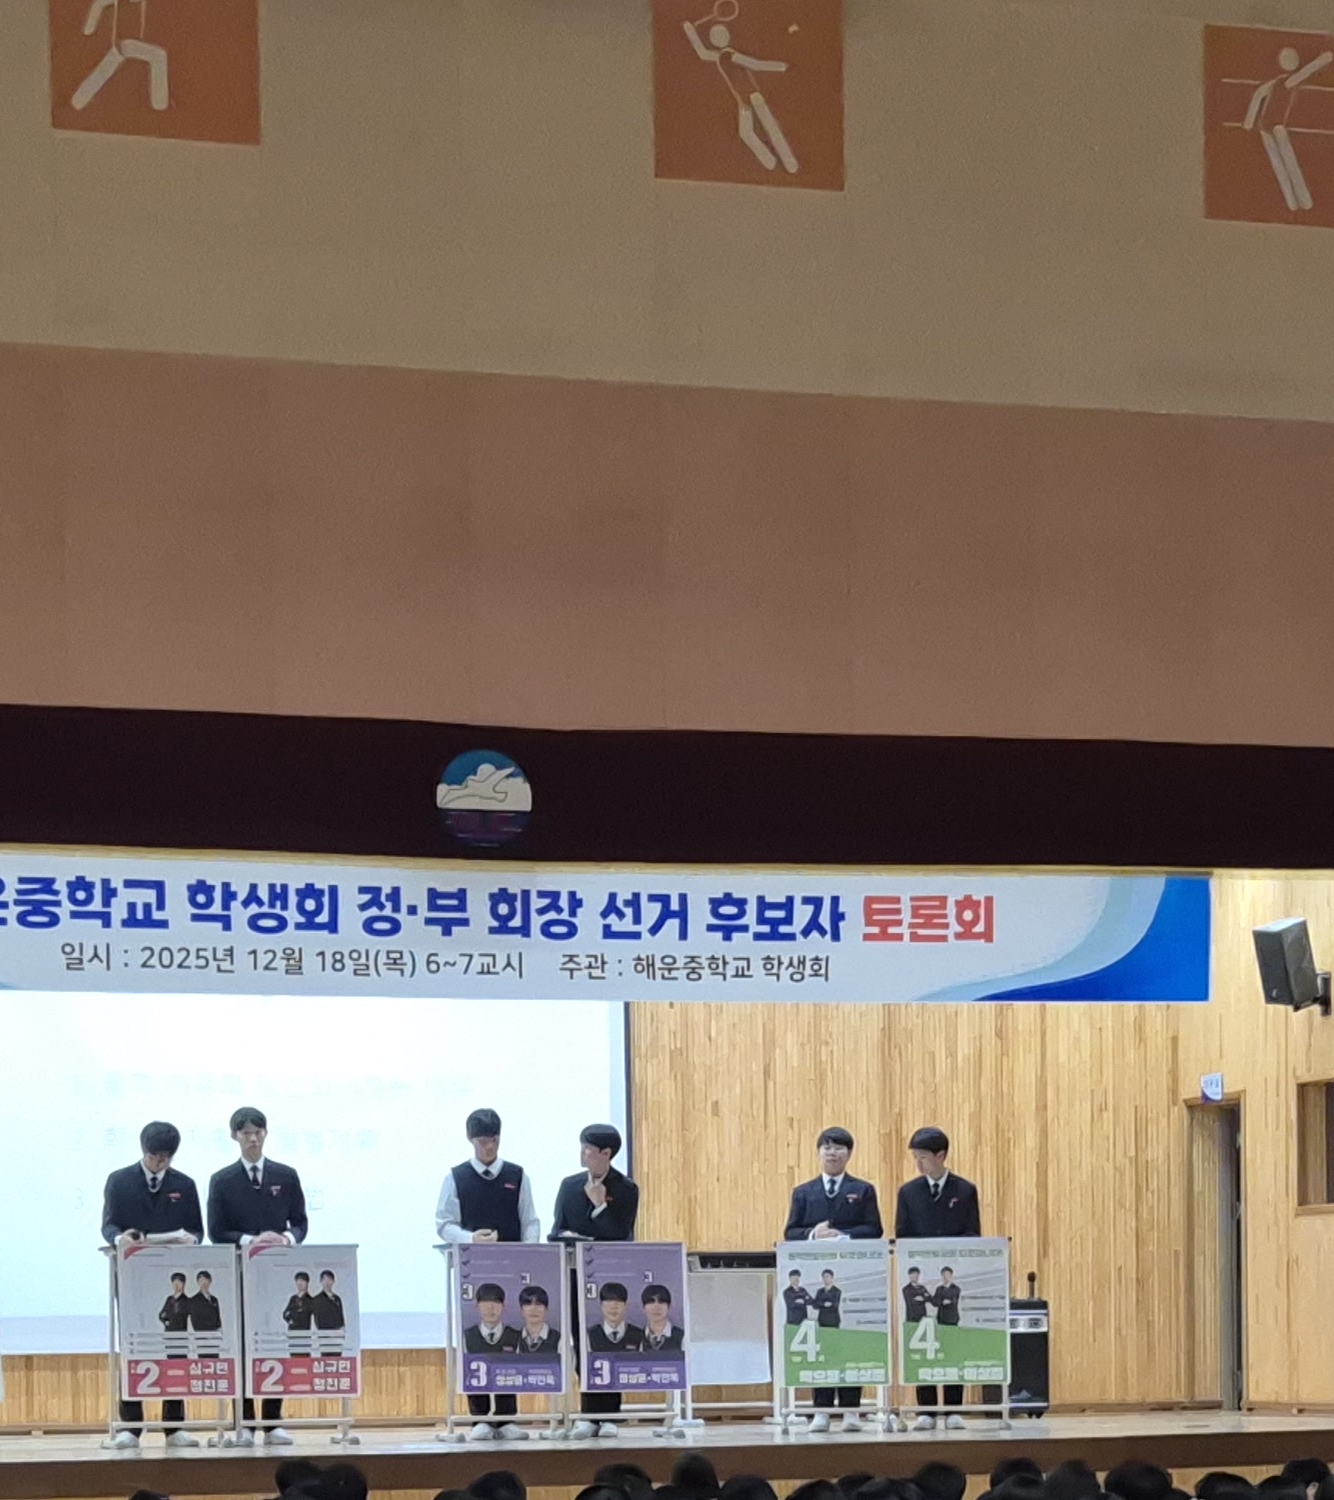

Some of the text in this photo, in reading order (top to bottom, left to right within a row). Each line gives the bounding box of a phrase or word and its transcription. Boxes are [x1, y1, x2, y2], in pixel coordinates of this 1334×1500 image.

[186, 878, 340, 936] 학생회
[356, 885, 471, 938] 정·부
[487, 887, 584, 942] 회장
[599, 891, 689, 942] 선거
[705, 892, 846, 943] 후보자
[861, 894, 995, 944] 토론회
[60, 942, 111, 971] 일시
[139, 945, 236, 974] 2025년
[247, 946, 304, 976] 12월
[315, 948, 417, 978] 18일(목)
[425, 951, 524, 980] 6~7교시
[558, 953, 609, 981] 주관
[631, 954, 753, 982] 해운중학교
[760, 955, 830, 983] 학생회
[789, 1319, 821, 1363] 4
[908, 1316, 940, 1360] 4
[135, 1361, 162, 1395] 2
[260, 1359, 285, 1393] 2
[470, 1360, 488, 1387] 3
[593, 1359, 612, 1386] 3
